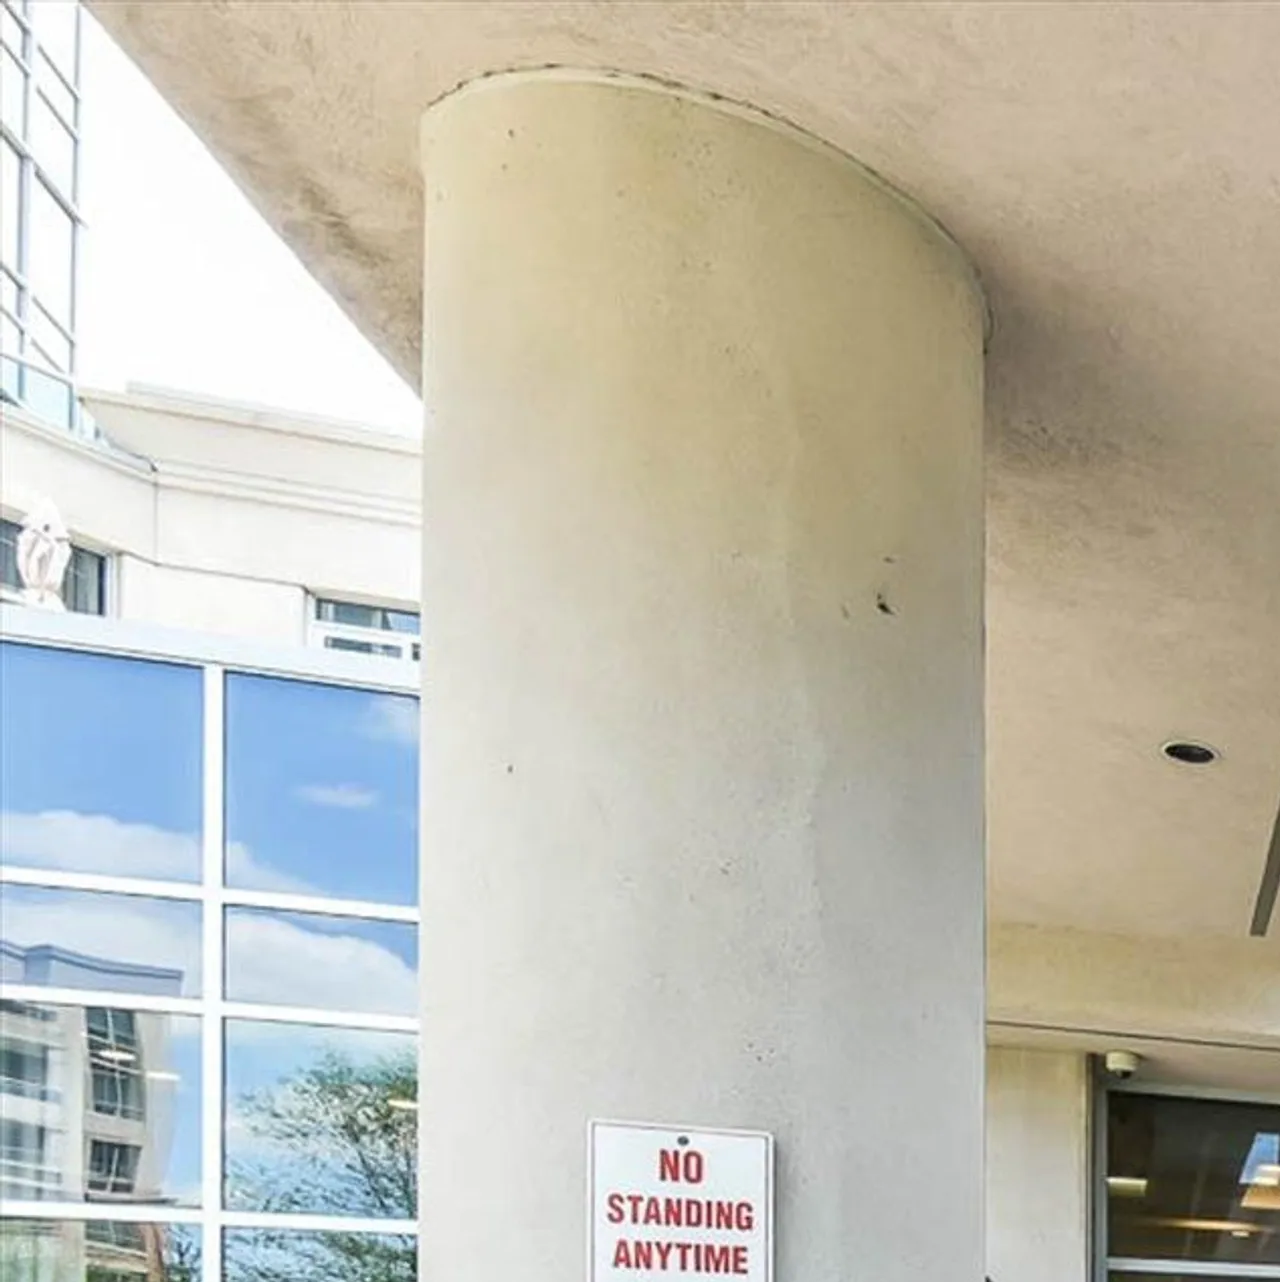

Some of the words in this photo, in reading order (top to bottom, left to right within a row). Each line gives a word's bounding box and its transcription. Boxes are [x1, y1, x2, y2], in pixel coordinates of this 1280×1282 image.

[659, 1149, 704, 1184] NO
[607, 1194, 754, 1230] STANDING
[613, 1240, 748, 1275] ANYTIME
